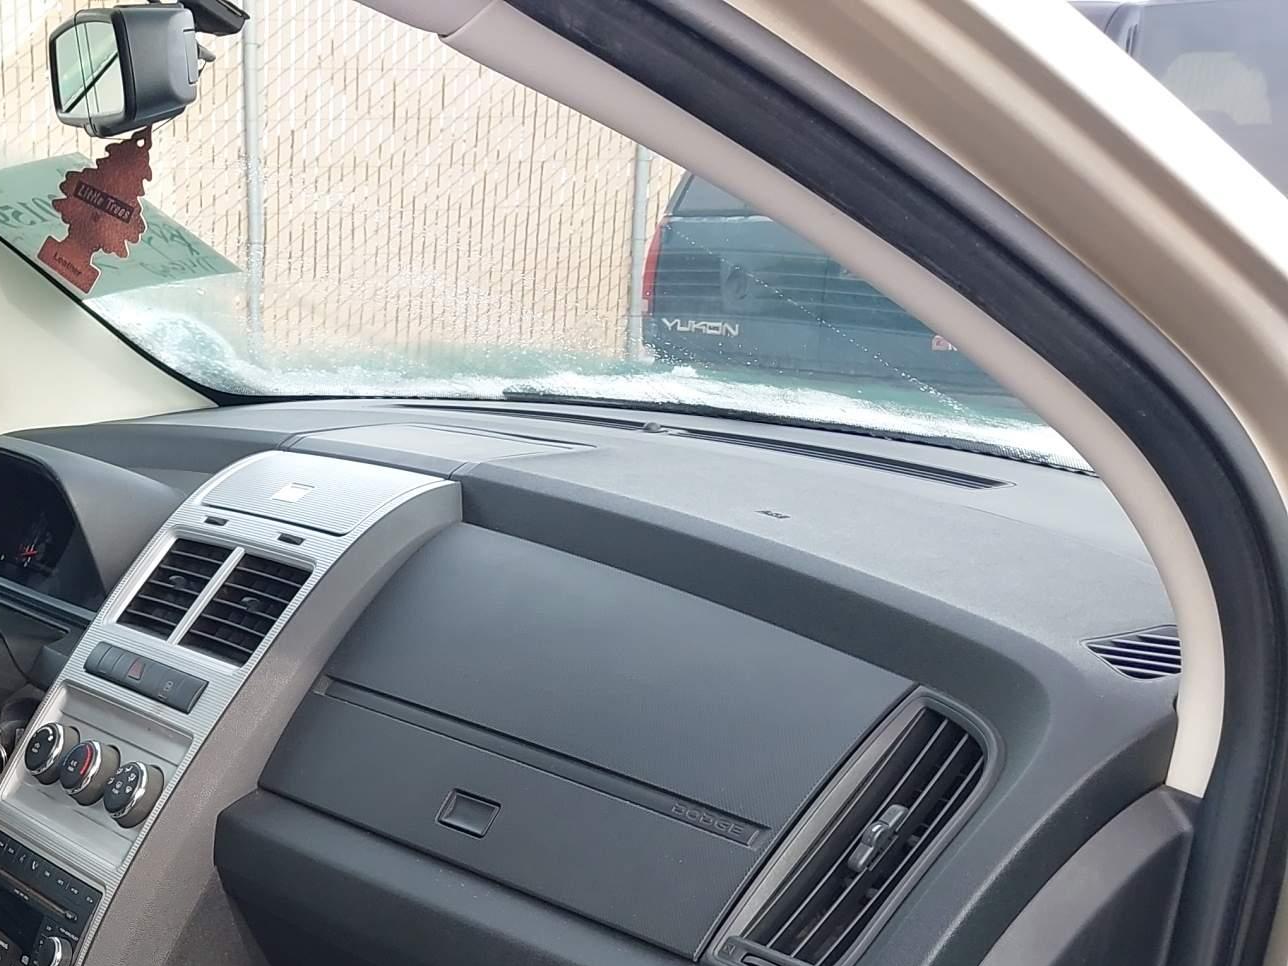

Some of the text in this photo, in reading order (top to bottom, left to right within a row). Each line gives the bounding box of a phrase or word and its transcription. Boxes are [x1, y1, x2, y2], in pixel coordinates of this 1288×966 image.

[77, 184, 130, 219] Little Trees
[661, 318, 740, 336] YUKON
[671, 803, 746, 837] DODGE
